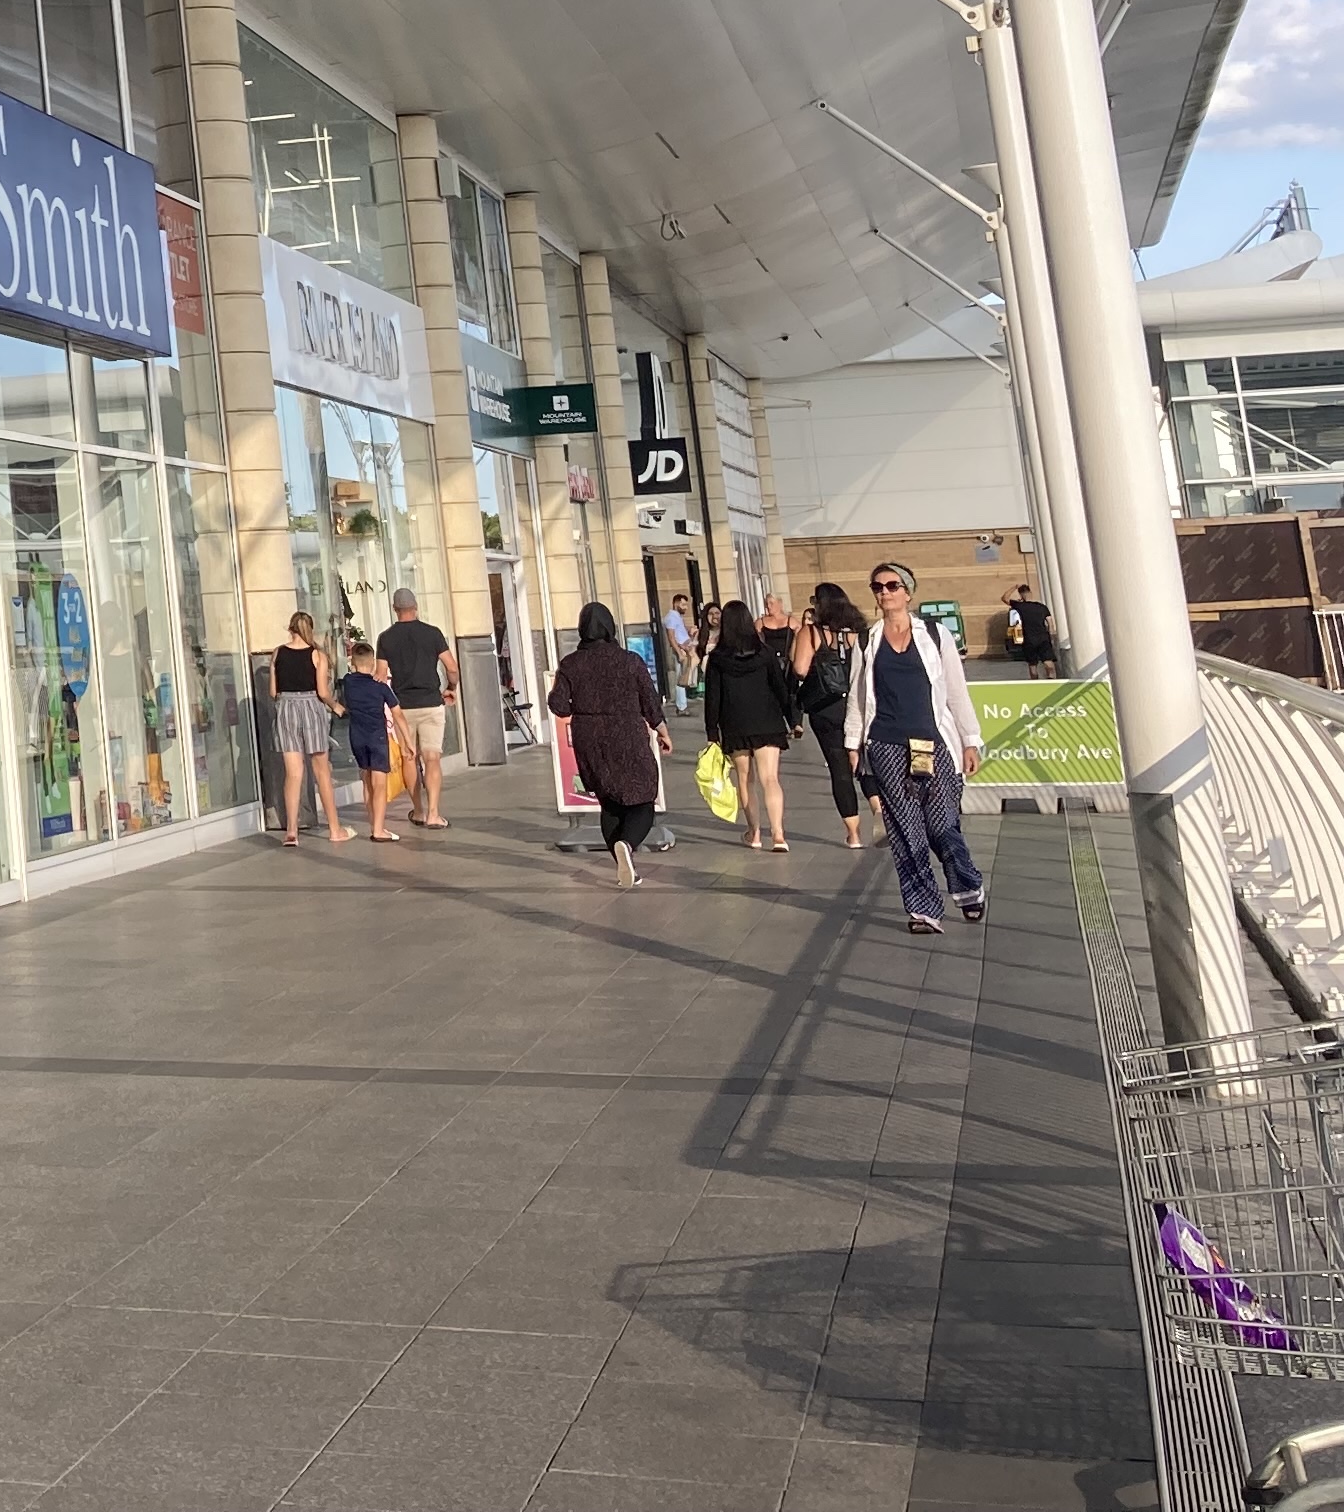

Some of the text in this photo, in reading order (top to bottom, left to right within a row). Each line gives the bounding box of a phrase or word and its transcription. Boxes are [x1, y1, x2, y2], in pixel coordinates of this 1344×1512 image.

[296, 280, 400, 380] RIVER ISLAND
[637, 450, 684, 484] JD
[983, 703, 1088, 719] No Access
[1024, 723, 1049, 739] To
[1077, 743, 1113, 760] Ave
